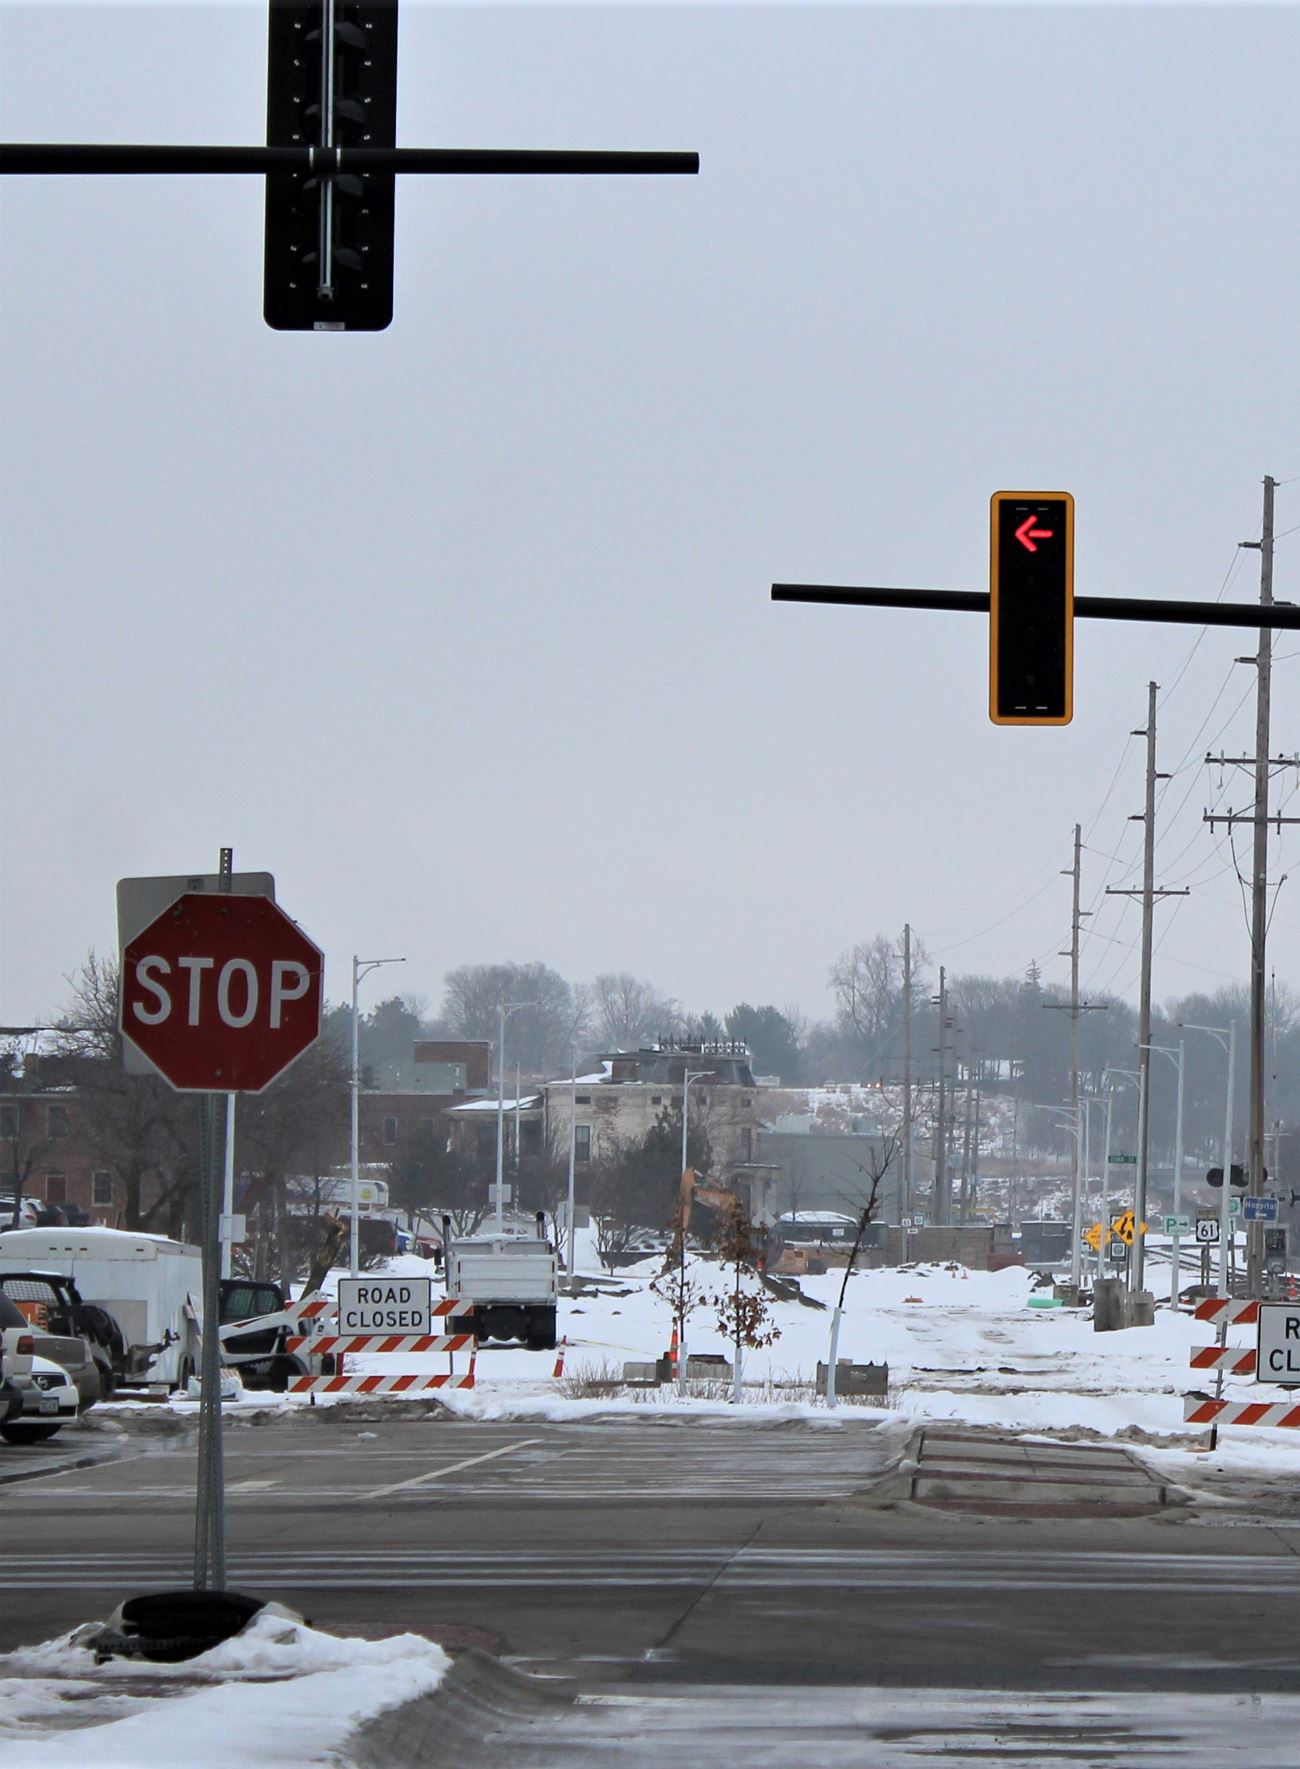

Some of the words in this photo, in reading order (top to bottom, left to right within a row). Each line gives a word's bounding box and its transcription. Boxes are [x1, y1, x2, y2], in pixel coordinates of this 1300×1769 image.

[132, 955, 311, 1030] STOP
[1245, 1201, 1278, 1212] Hospital
[1166, 1218, 1177, 1233] P
[1200, 1224, 1214, 1238] 61
[356, 1287, 411, 1305] ROAD
[346, 1309, 424, 1329] CLOSED
